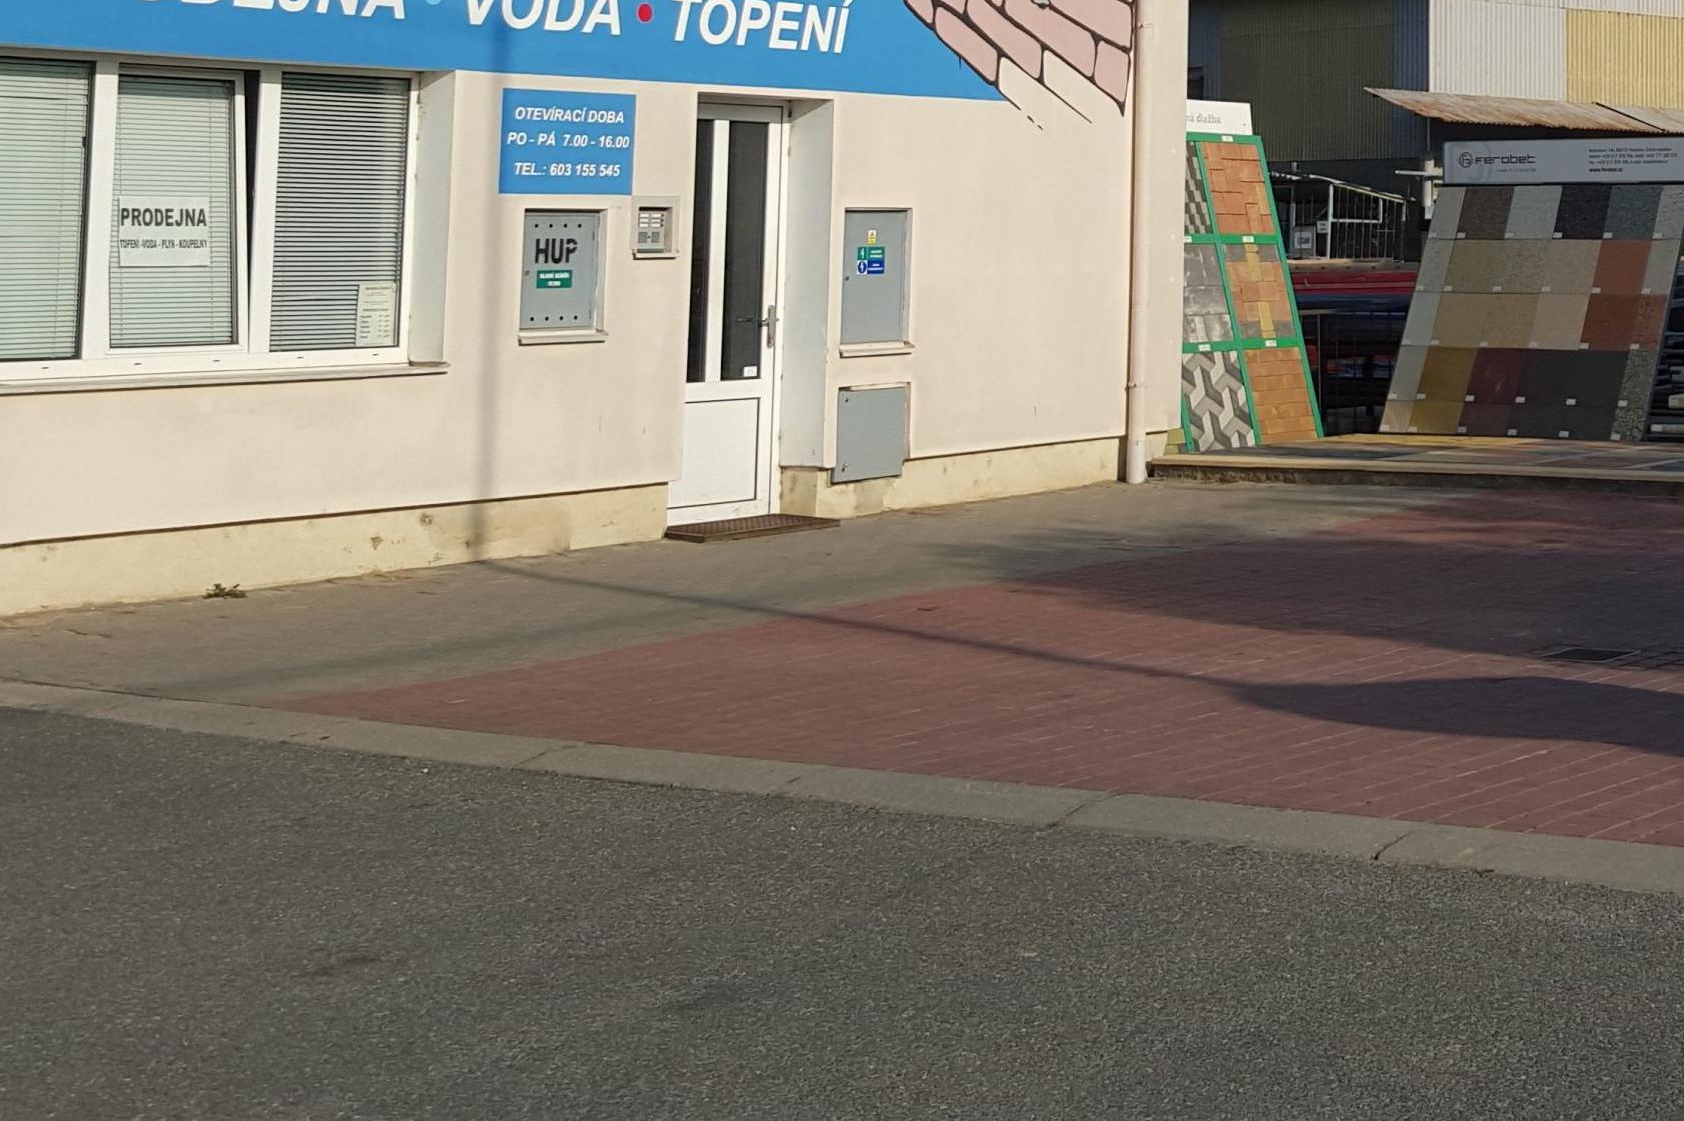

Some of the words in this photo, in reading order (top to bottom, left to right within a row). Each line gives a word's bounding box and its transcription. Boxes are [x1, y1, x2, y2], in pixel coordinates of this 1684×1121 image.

[515, 106, 587, 122] OTEVÍRACÍ
[588, 111, 624, 123] DOBA
[507, 132, 527, 145] PO
[538, 131, 556, 146] PÁ
[563, 134, 588, 147] 7.00
[599, 136, 630, 148] 16.00
[515, 162, 546, 175] TEL.:
[550, 163, 571, 176] 603
[575, 164, 596, 176] 155
[599, 164, 620, 176] 545
[121, 208, 207, 226] PRODEJNA
[535, 238, 578, 264] HUP
